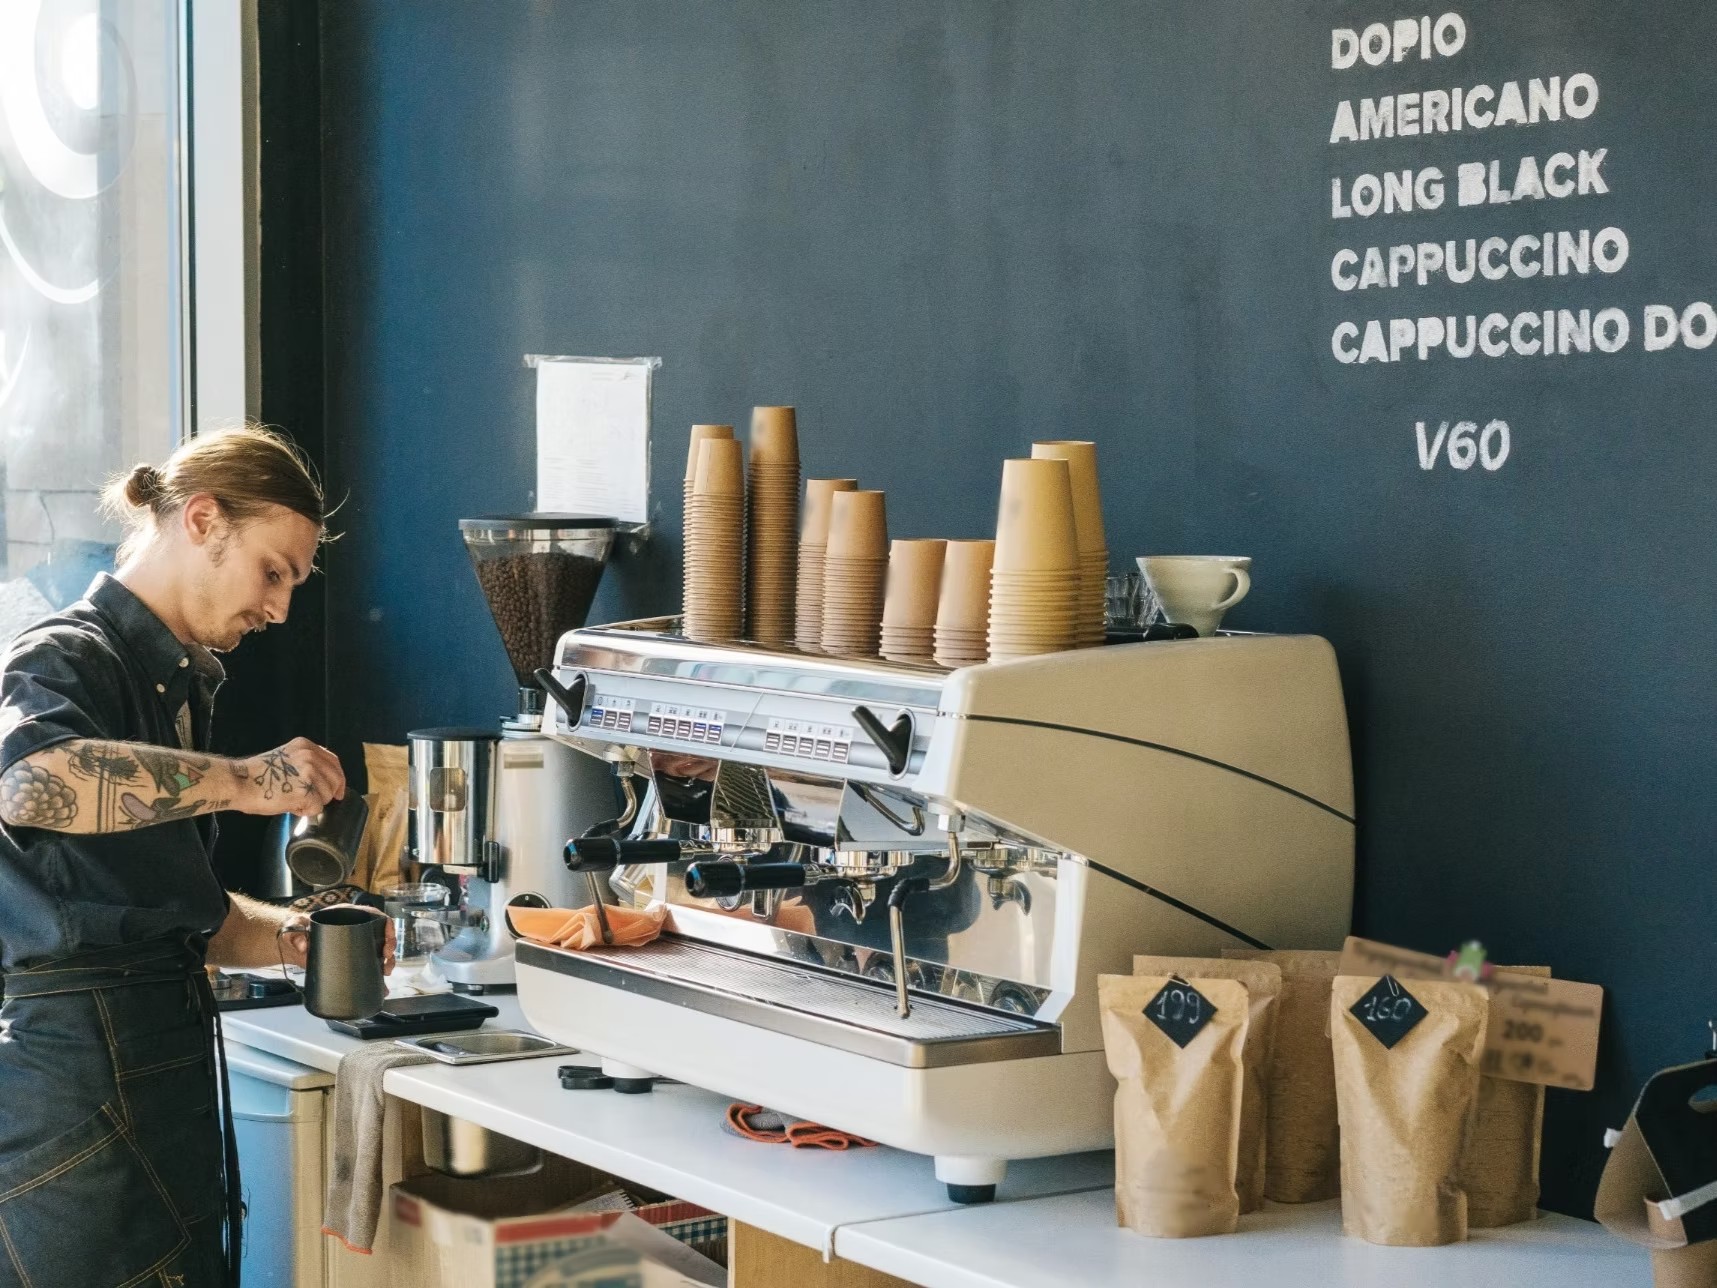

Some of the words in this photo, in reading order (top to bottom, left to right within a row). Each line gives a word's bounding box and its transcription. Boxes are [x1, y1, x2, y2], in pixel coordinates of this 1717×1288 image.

[1331, 12, 1467, 70] DOPIO
[1329, 73, 1600, 143] AMERICANO
[1331, 166, 1445, 219] LONG
[1457, 148, 1610, 207] BLACK
[1331, 226, 1630, 292] CAPPUCCINO
[1331, 307, 1631, 364] CAPPUCCINO
[1643, 301, 1717, 352] DO
[1414, 419, 1511, 471] V60
[1156, 988, 1200, 1025] 199
[1363, 996, 1412, 1021] 160
